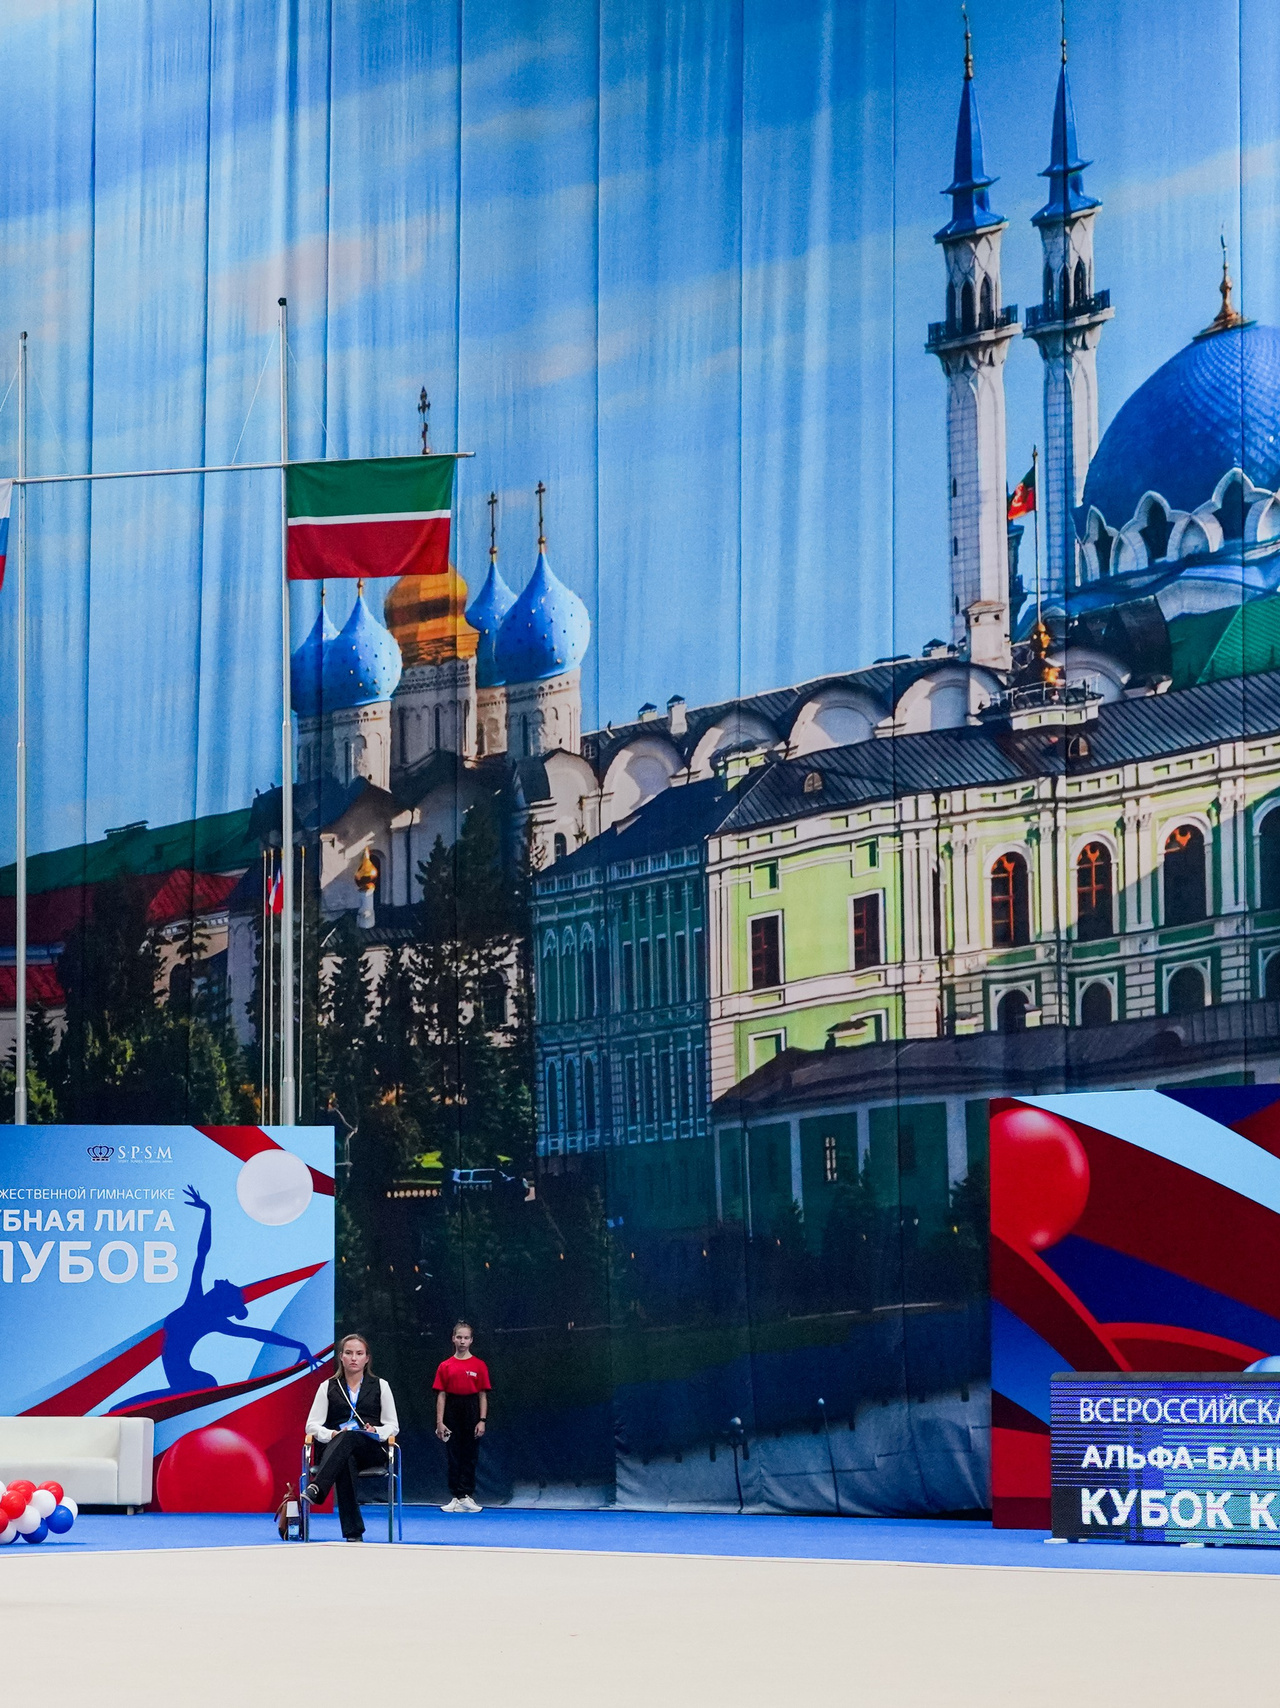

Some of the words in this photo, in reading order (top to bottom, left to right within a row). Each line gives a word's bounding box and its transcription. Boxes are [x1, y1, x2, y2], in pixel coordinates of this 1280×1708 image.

[89, 1188, 175, 1200] ГИМНАСТИКЕ
[93, 1209, 175, 1232] ЛИГА
[1079, 1393, 1280, 1424] ВСЕРОССИЙСК
[1081, 1444, 1280, 1472] АЛЬФА-БАН
[1081, 1487, 1235, 1530] КУБОК
